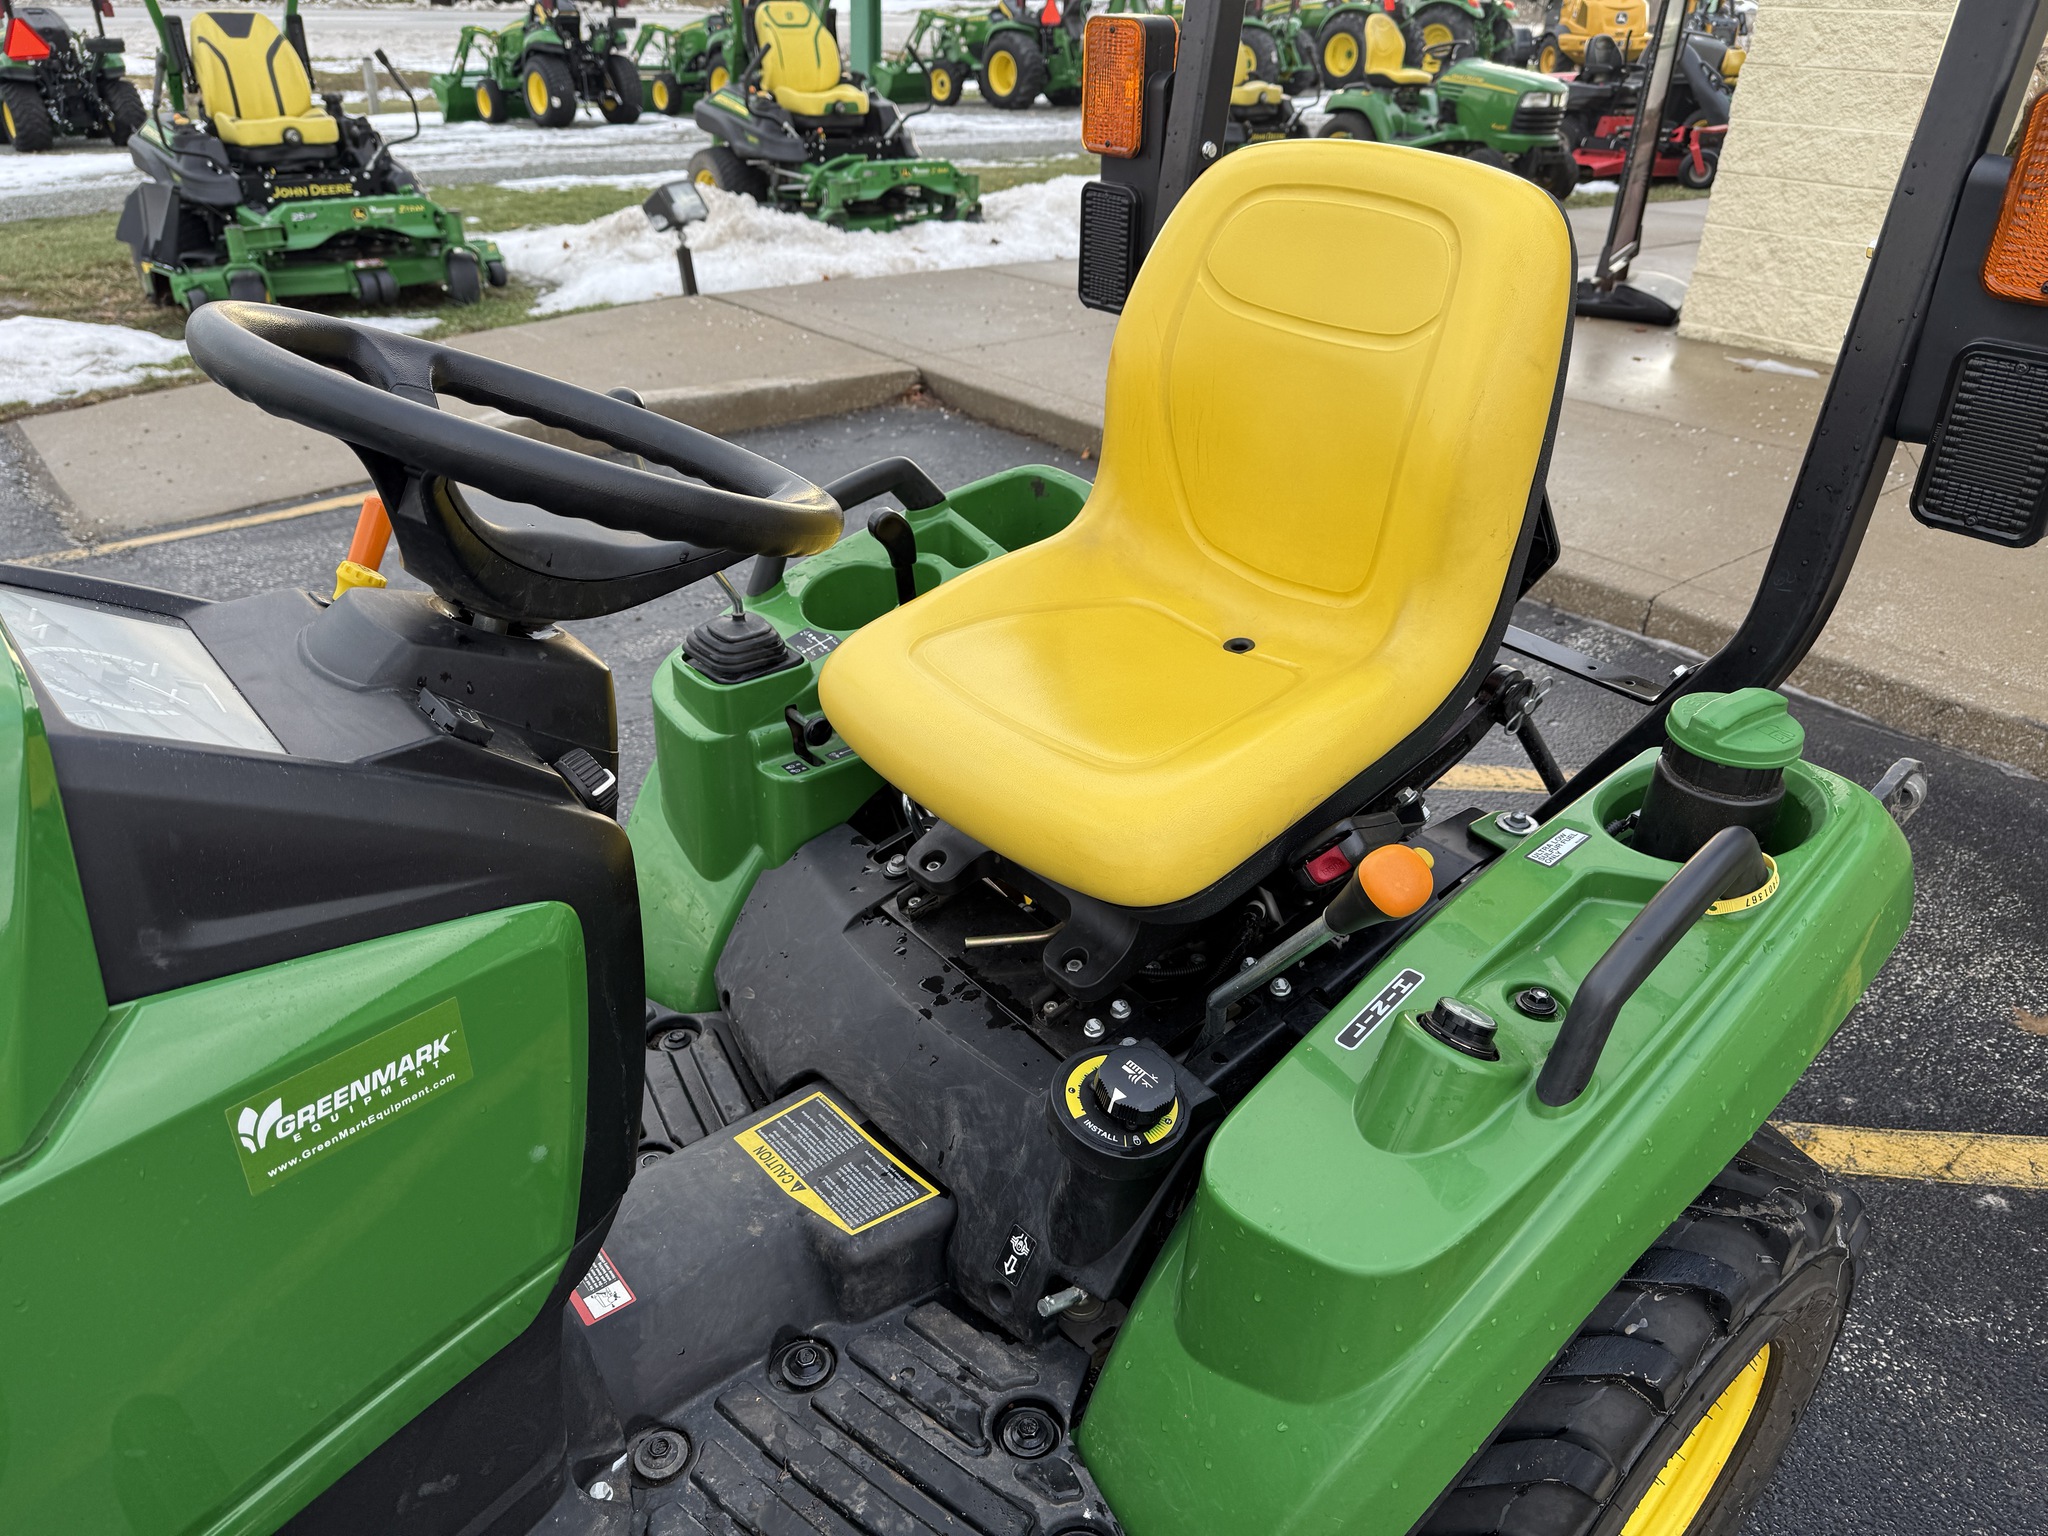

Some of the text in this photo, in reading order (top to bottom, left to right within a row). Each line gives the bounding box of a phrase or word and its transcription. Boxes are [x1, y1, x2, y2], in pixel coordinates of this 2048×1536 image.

[272, 183, 353, 199] JOHN DEERE
[1532, 843, 1553, 859] ULTRA
[1552, 832, 1567, 844] LOW
[1538, 843, 1563, 861] SULFUR
[1561, 832, 1579, 845] FUEL
[1545, 851, 1562, 864] ONLY
[275, 1033, 451, 1139] GREENMARK
[293, 1060, 441, 1143] EQUIPMENT
[267, 1072, 456, 1178] www.GreenMarkEquipment.com
[1083, 1119, 1119, 1143] INSTALL
[753, 1145, 796, 1184] CAUTION
